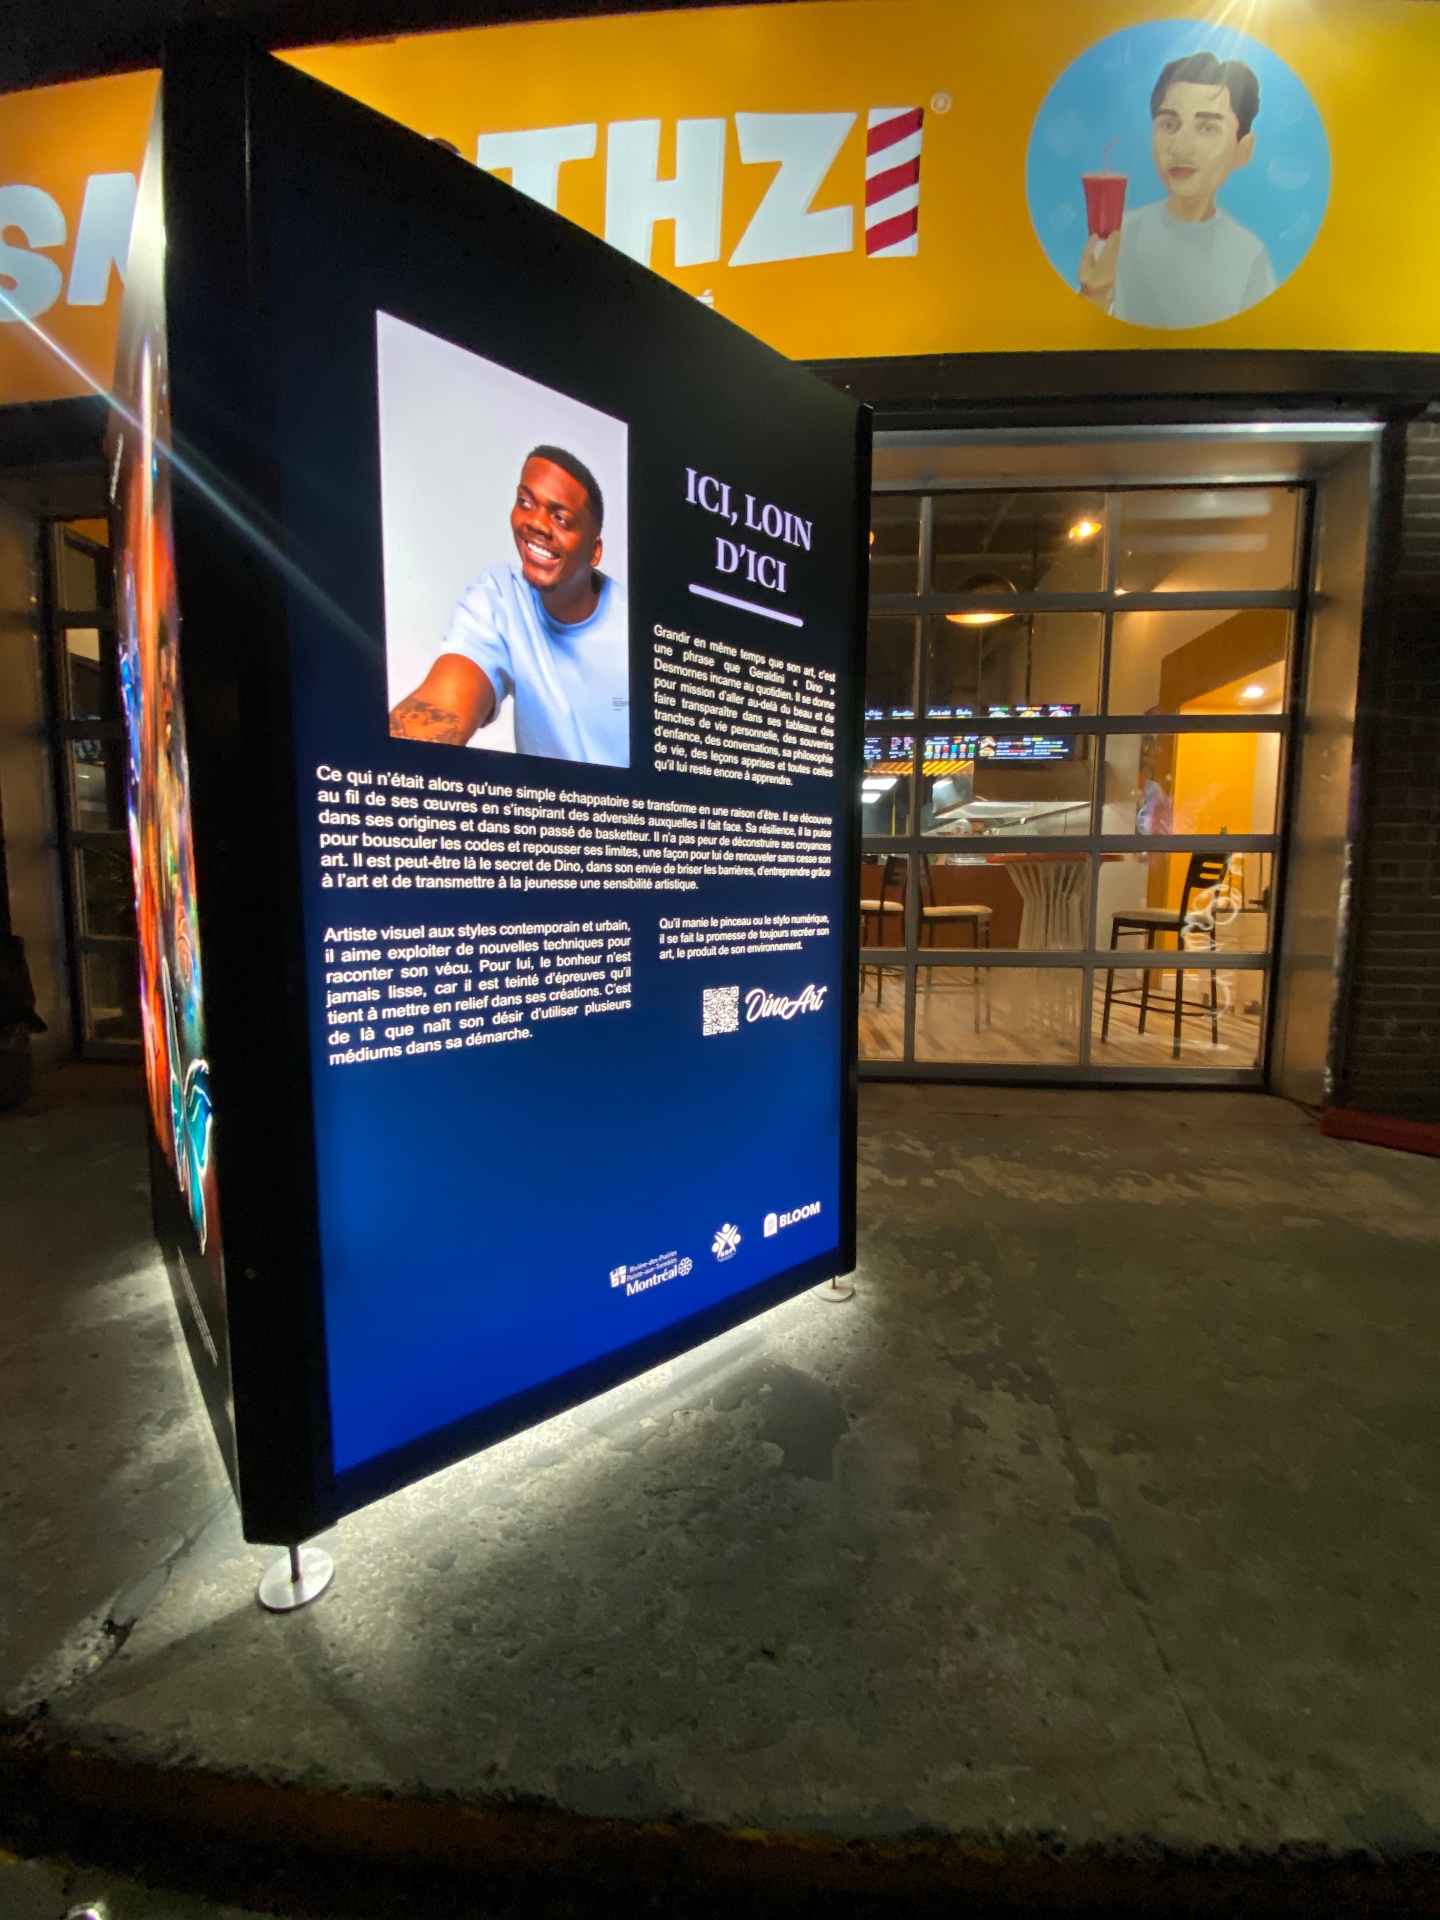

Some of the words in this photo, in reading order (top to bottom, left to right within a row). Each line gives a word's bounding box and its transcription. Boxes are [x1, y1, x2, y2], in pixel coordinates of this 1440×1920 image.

[685, 467, 738, 526] ICI,
[744, 494, 813, 551] LOIN
[715, 537, 787, 593] D'ICI
[653, 625, 691, 644] Grandir
[693, 638, 707, 649] en
[709, 642, 738, 657] même
[740, 649, 766, 665] temps
[768, 658, 785, 670] que
[786, 663, 801, 674] son
[803, 667, 817, 679] art,
[818, 670, 836, 683] c'est
[654, 692, 677, 707] faire
[681, 698, 738, 719] transparaître
[742, 711, 763, 724] dans
[767, 717, 782, 728] ses
[785, 719, 818, 734] tableaux
[820, 726, 835, 737] des
[654, 709, 696, 726] tranches
[699, 717, 711, 729] de
[714, 721, 728, 732] vie
[731, 725, 780, 742] personnelle,
[782, 733, 798, 745] des
[799, 738, 835, 751] souvenirs
[316, 765, 343, 782] Ce
[346, 770, 373, 787] qui
[377, 772, 425, 789] n'était
[428, 777, 464, 793] alors
[467, 782, 513, 797] qu'une
[516, 786, 557, 803] simple
[559, 790, 630, 808] échappatoire
[632, 799, 645, 810] se
[646, 800, 698, 814] transforme
[698, 806, 711, 815] en
[712, 807, 729, 817] une
[730, 808, 756, 819] raison
[756, 809, 781, 821] d'être.
[782, 811, 788, 822] Il
[789, 814, 800, 823] se
[799, 813, 833, 825] découvre
[317, 790, 340, 803] au
[344, 789, 360, 804] fil
[364, 791, 387, 807] de
[391, 796, 419, 809] ses
[423, 799, 478, 813] œuvres
[481, 803, 500, 815] en
[503, 803, 566, 820] s'inspirant
[568, 809, 590, 822] des
[592, 812, 646, 825] adversités
[648, 817, 698, 830] auxquelles
[700, 819, 706, 830] il
[707, 819, 722, 831] fait
[722, 821, 743, 832] face.
[745, 822, 758, 834] Sa
[758, 824, 797, 837] résilience,
[798, 826, 803, 836] il
[804, 827, 812, 837] la
[812, 828, 832, 839] puise
[321, 873, 334, 888] à
[337, 873, 369, 888] l'art
[372, 874, 389, 888] et
[391, 874, 412, 888] de
[414, 876, 496, 889] transmettre
[498, 876, 507, 889] à
[510, 876, 522, 889] la
[524, 878, 578, 891] jeunesse
[580, 879, 601, 889] une
[603, 878, 653, 890] sensibilité
[654, 879, 699, 891] artistique.
[324, 927, 378, 942] Artiste
[380, 925, 425, 940] visuel
[428, 927, 456, 939] aux
[457, 924, 497, 940] styles
[499, 922, 580, 936] contemporain
[582, 921, 594, 932] et
[595, 920, 631, 932] urbain,
[659, 918, 681, 929] Qu'il
[682, 917, 710, 928] manie
[710, 917, 719, 927] le
[720, 917, 752, 929] pinceau
[752, 917, 764, 926] ou
[764, 915, 772, 925] le
[772, 915, 791, 927] stylo
[791, 914, 830, 925] numérique,
[659, 933, 665, 944] il
[666, 935, 679, 944] se
[680, 932, 695, 943] fait
[696, 932, 705, 943] la
[706, 932, 747, 944] promesse
[747, 930, 759, 940] de
[759, 929, 790, 941] toujours
[790, 927, 816, 937] recréer
[816, 928, 830, 936] son
[325, 948, 335, 963] il
[341, 948, 382, 963] aime
[387, 944, 452, 961] exploiter
[455, 942, 474, 956] de
[479, 940, 540, 954] nouvelles
[543, 938, 604, 951] techniques
[607, 937, 632, 950] pour
[326, 968, 394, 984] raconter
[400, 966, 429, 979] son
[435, 962, 473, 976] vécu.
[479, 959, 511, 972] Pour
[516, 957, 534, 970] lui,
[540, 956, 552, 968] le
[556, 954, 603, 967] bonheur
[606, 951, 632, 963] n'est
[659, 949, 675, 960] art,
[676, 948, 686, 958] le
[687, 946, 718, 960] produit
[718, 945, 730, 956] de
[730, 946, 746, 955] son
[746, 941, 804, 953] environnement.
[326, 987, 381, 1008] jamais
[388, 985, 427, 999] lisse,
[434, 983, 458, 995] car
[464, 979, 472, 992] il
[478, 978, 500, 991] est
[504, 974, 540, 988] teinté
[544, 971, 606, 985] d'épreuves
[610, 966, 632, 981] qu'il
[327, 1009, 365, 1025] tient
[367, 1007, 378, 1021] à
[381, 1004, 431, 1019] mettre
[433, 1002, 452, 1014] en
[455, 995, 490, 1011] relief
[491, 995, 523, 1007] dans
[525, 993, 547, 1004] ses
[548, 987, 603, 1001] créations.
[604, 983, 632, 995] C'est
[328, 1030, 351, 1045] de
[360, 1027, 376, 1042] là
[384, 1025, 415, 1041] que
[423, 1018, 452, 1033] naît
[459, 1017, 484, 1029] son
[492, 1010, 524, 1025] désir
[530, 1006, 579, 1020] d'utiliser
[585, 1000, 632, 1016] plusieurs
[329, 1046, 403, 1065] médiums
[405, 1040, 443, 1055] dans
[445, 1038, 463, 1049] sa
[465, 1028, 533, 1046] démarche.
[779, 1201, 821, 1228] BLOOM
[626, 1264, 678, 1297] Montréal
